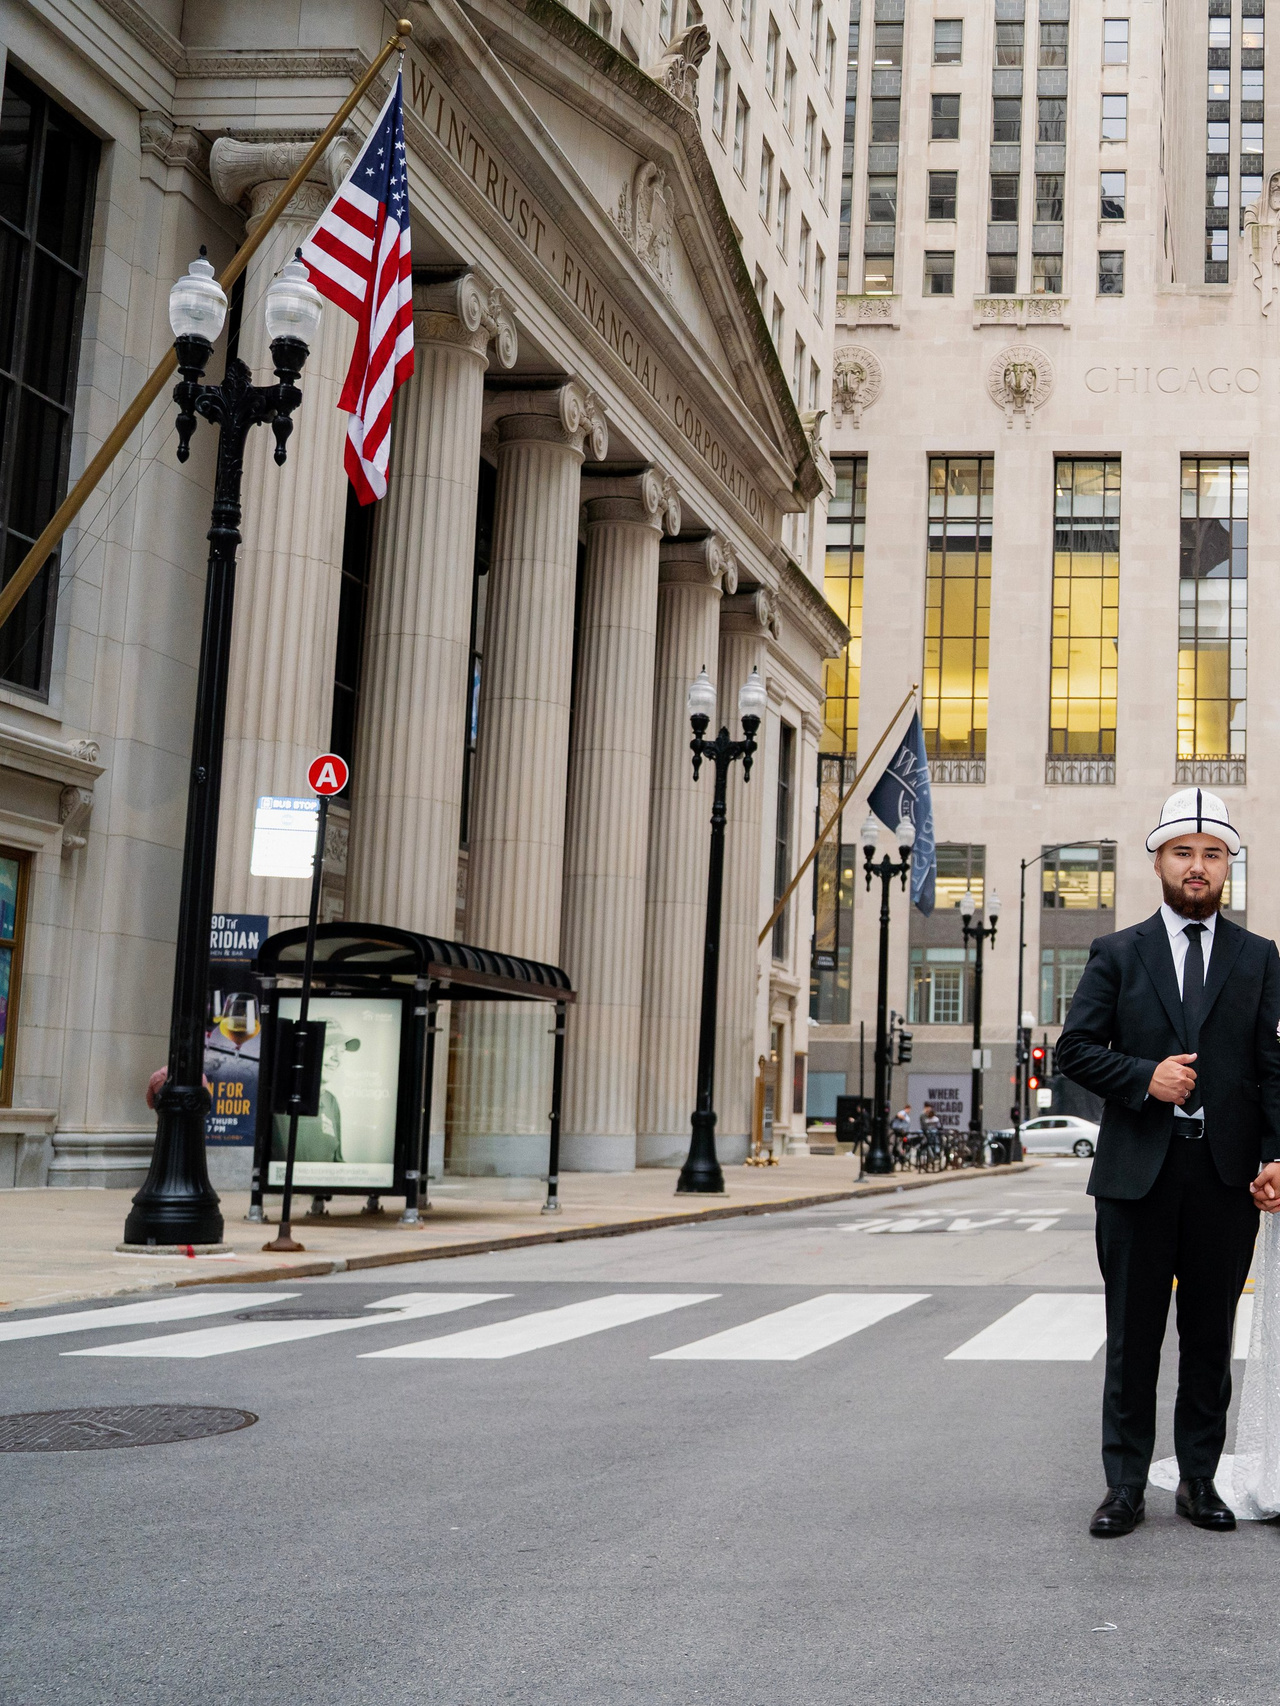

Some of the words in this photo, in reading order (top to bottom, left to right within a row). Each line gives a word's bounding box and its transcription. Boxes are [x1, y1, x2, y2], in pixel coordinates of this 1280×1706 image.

[409, 57, 546, 257] WINTRUST
[562, 253, 661, 404] FINANCIAL
[673, 394, 766, 526] CORPORATION
[1084, 366, 1261, 395] CHICAGO
[315, 762, 338, 788] A
[272, 799, 292, 809] BUS
[293, 801, 318, 810] STOP
[209, 930, 260, 951] RIDIAN
[217, 1081, 244, 1099] FOR
[928, 1088, 959, 1100] WHERE
[216, 1098, 251, 1116] HOUR
[211, 1117, 239, 1126] THURS
